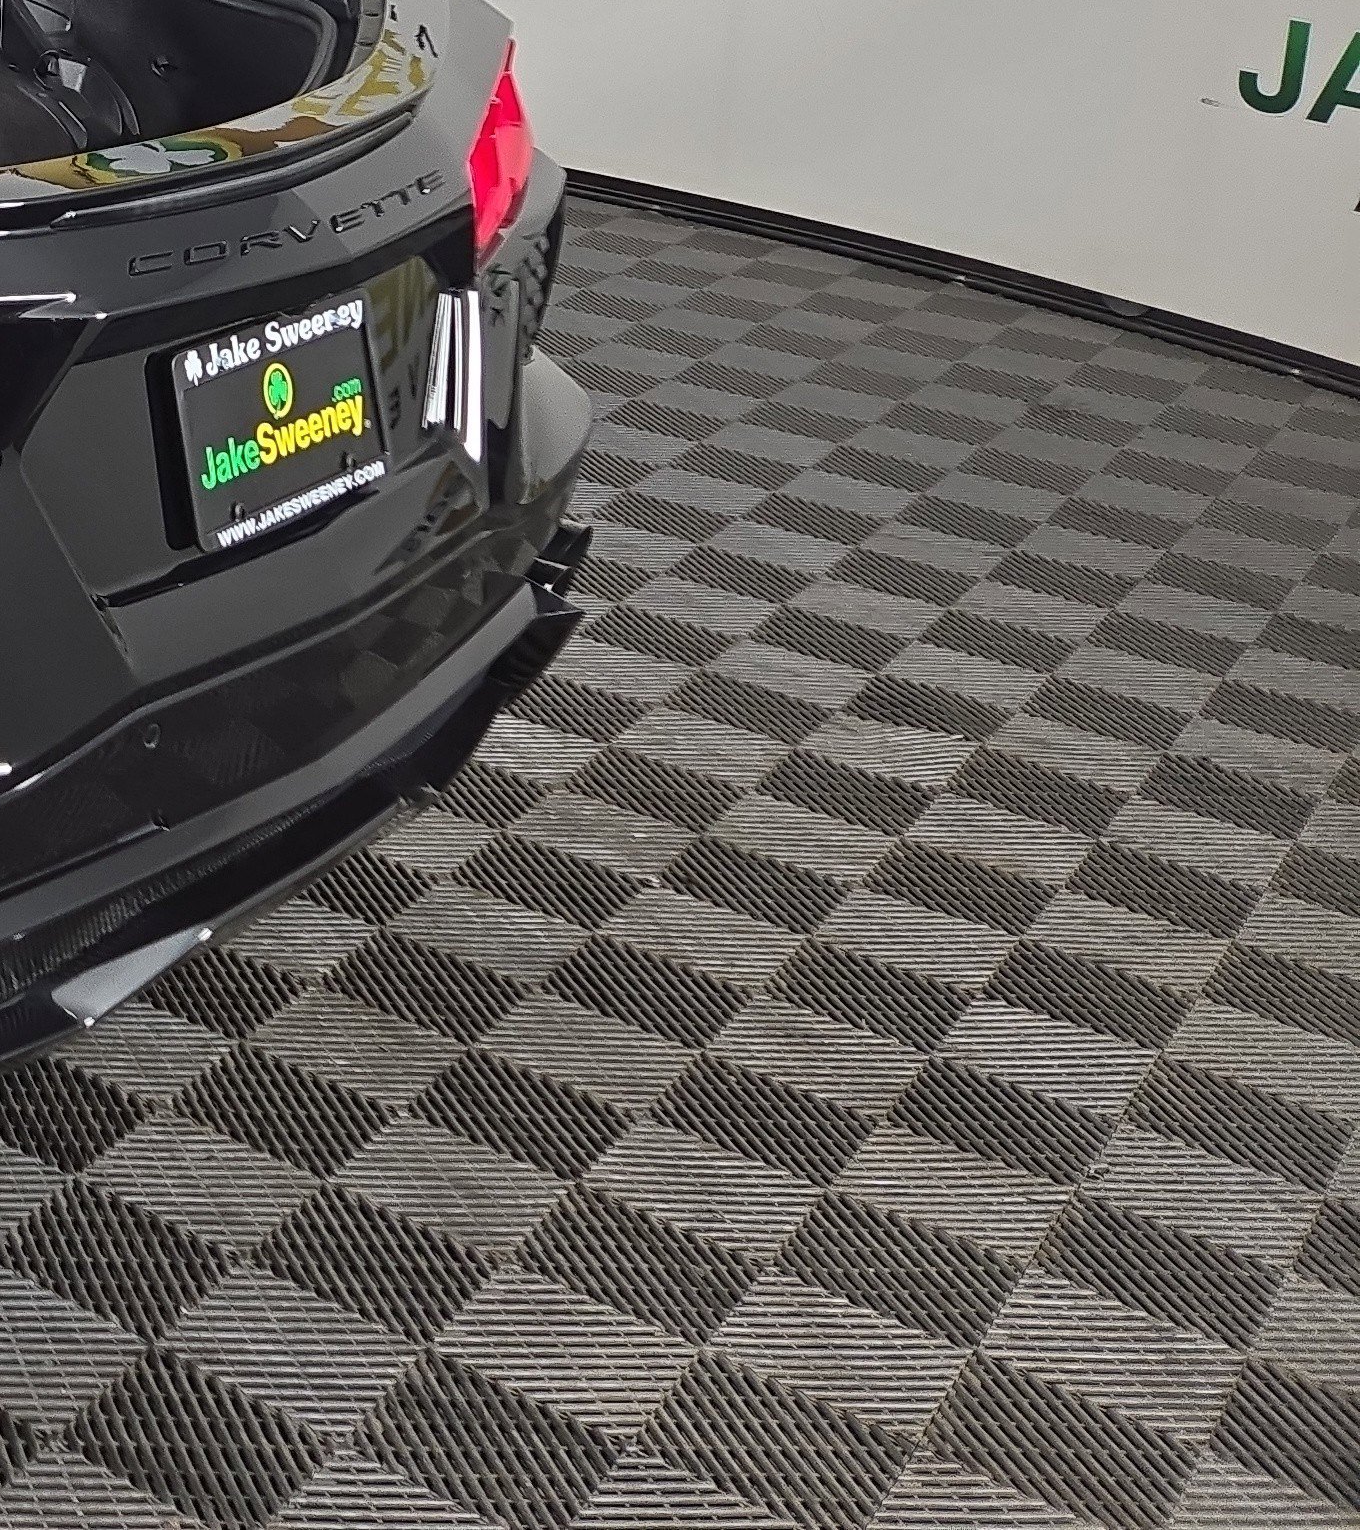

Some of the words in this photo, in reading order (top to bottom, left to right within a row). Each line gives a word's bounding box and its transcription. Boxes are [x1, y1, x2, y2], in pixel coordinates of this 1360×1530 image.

[128, 169, 447, 278] CORVETTE
[205, 334, 262, 377] Jake
[331, 378, 362, 402] .com
